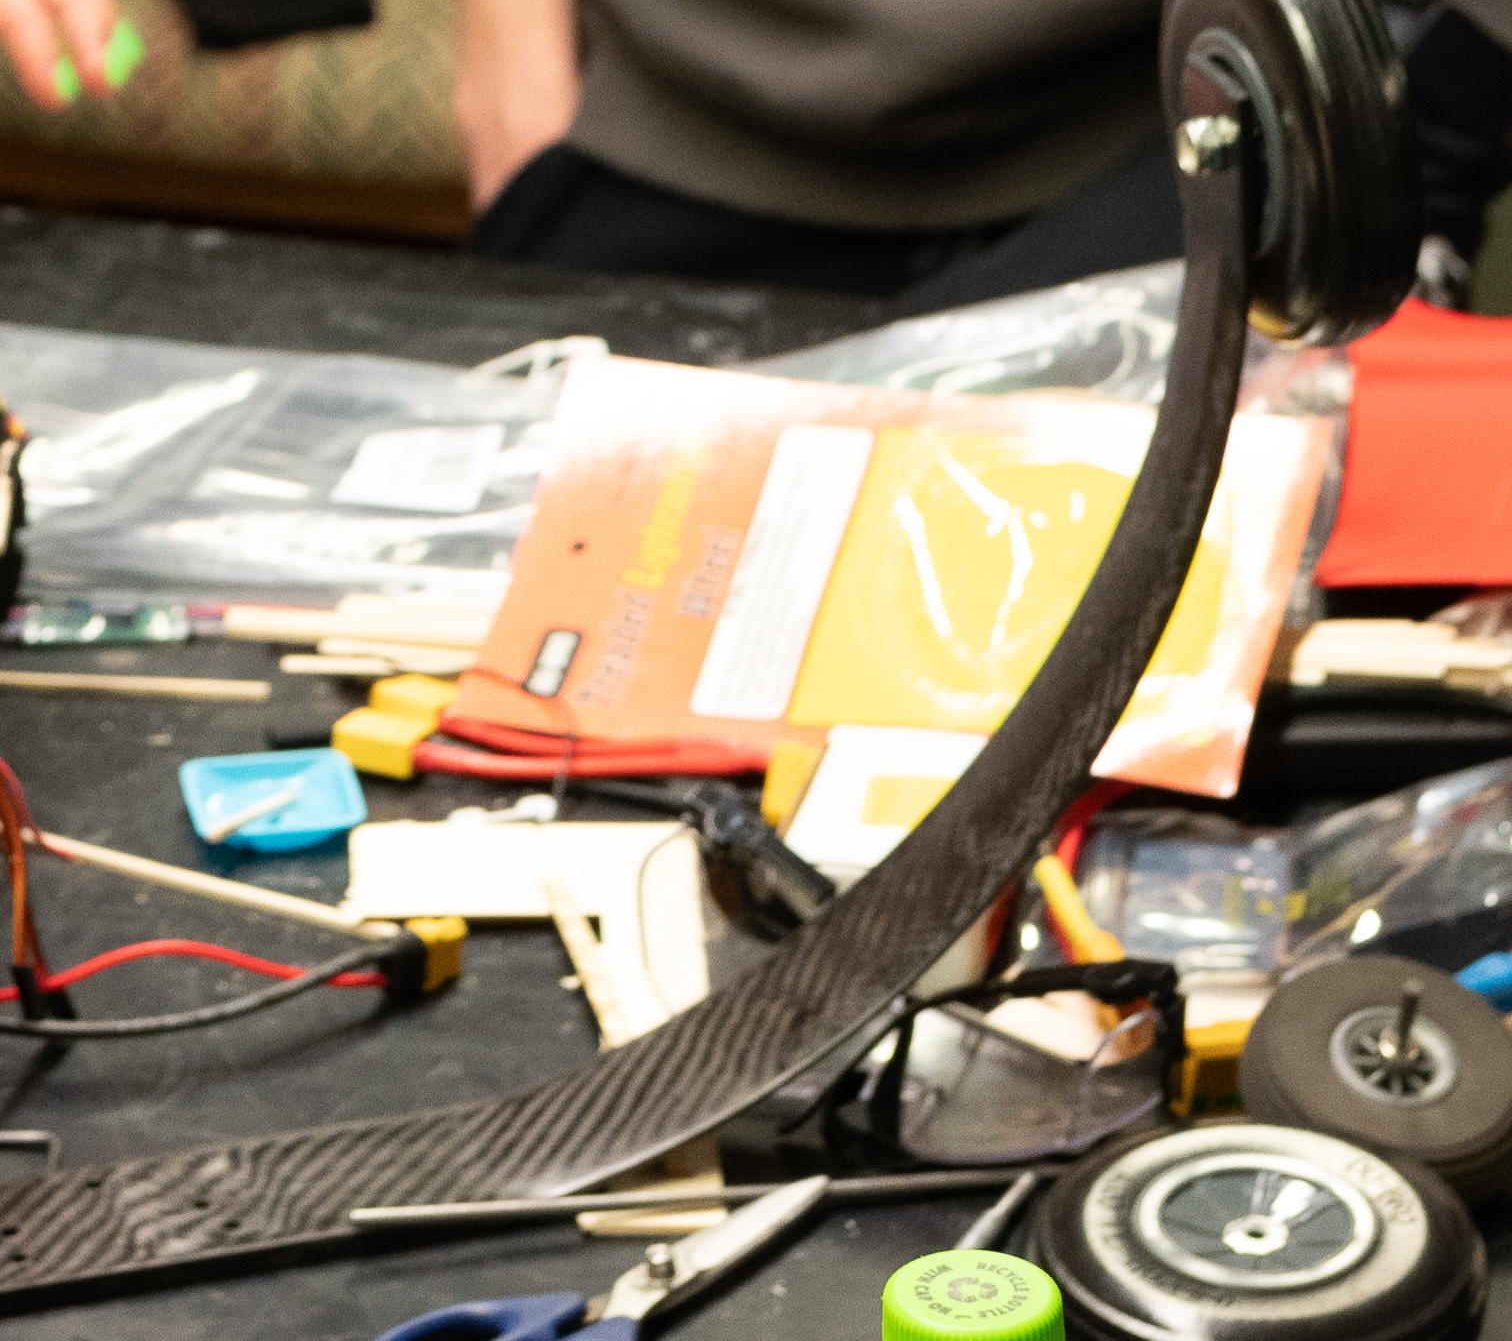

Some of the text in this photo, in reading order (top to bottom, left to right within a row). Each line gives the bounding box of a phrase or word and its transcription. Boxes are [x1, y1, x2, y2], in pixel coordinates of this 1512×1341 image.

[914, 1264, 954, 1315] WITH CAP ON
[976, 1262, 1030, 1318] RECYCLE BOTTLE
